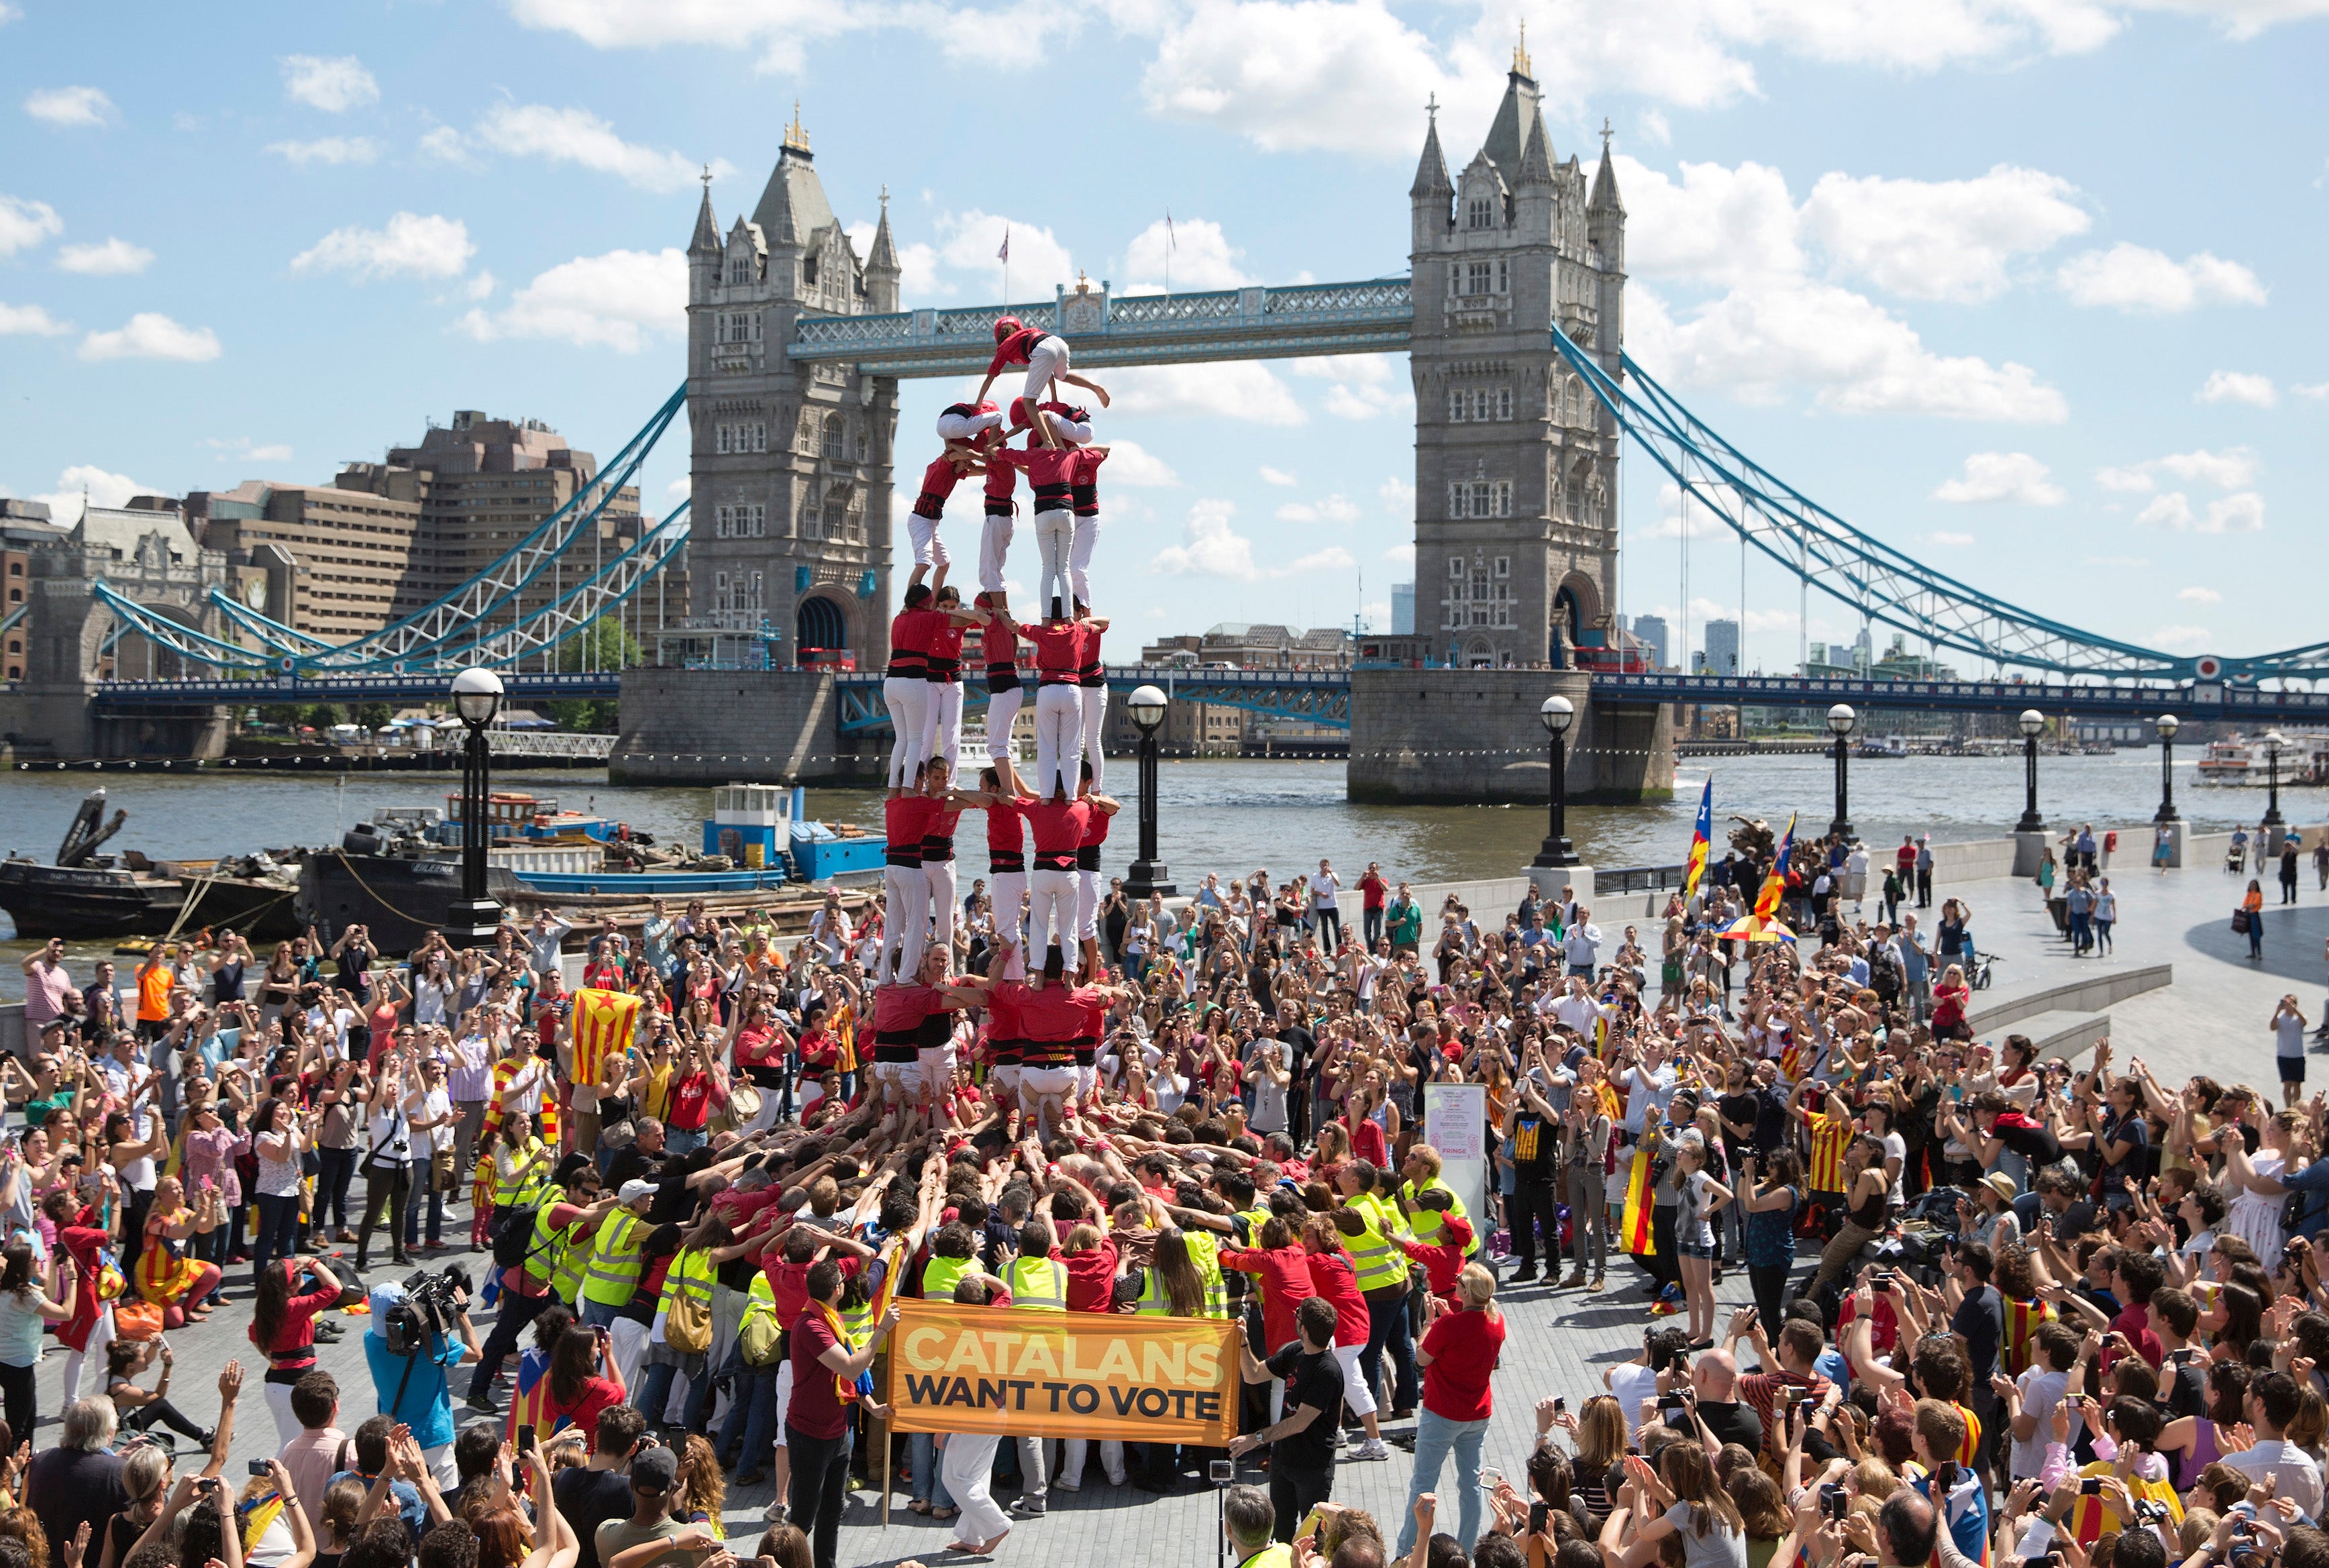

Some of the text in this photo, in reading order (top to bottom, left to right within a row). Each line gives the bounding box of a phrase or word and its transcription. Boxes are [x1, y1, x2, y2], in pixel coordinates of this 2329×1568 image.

[904, 1327, 1224, 1388] CATALANS
[904, 1373, 1221, 1421] WANT TO VOTE
